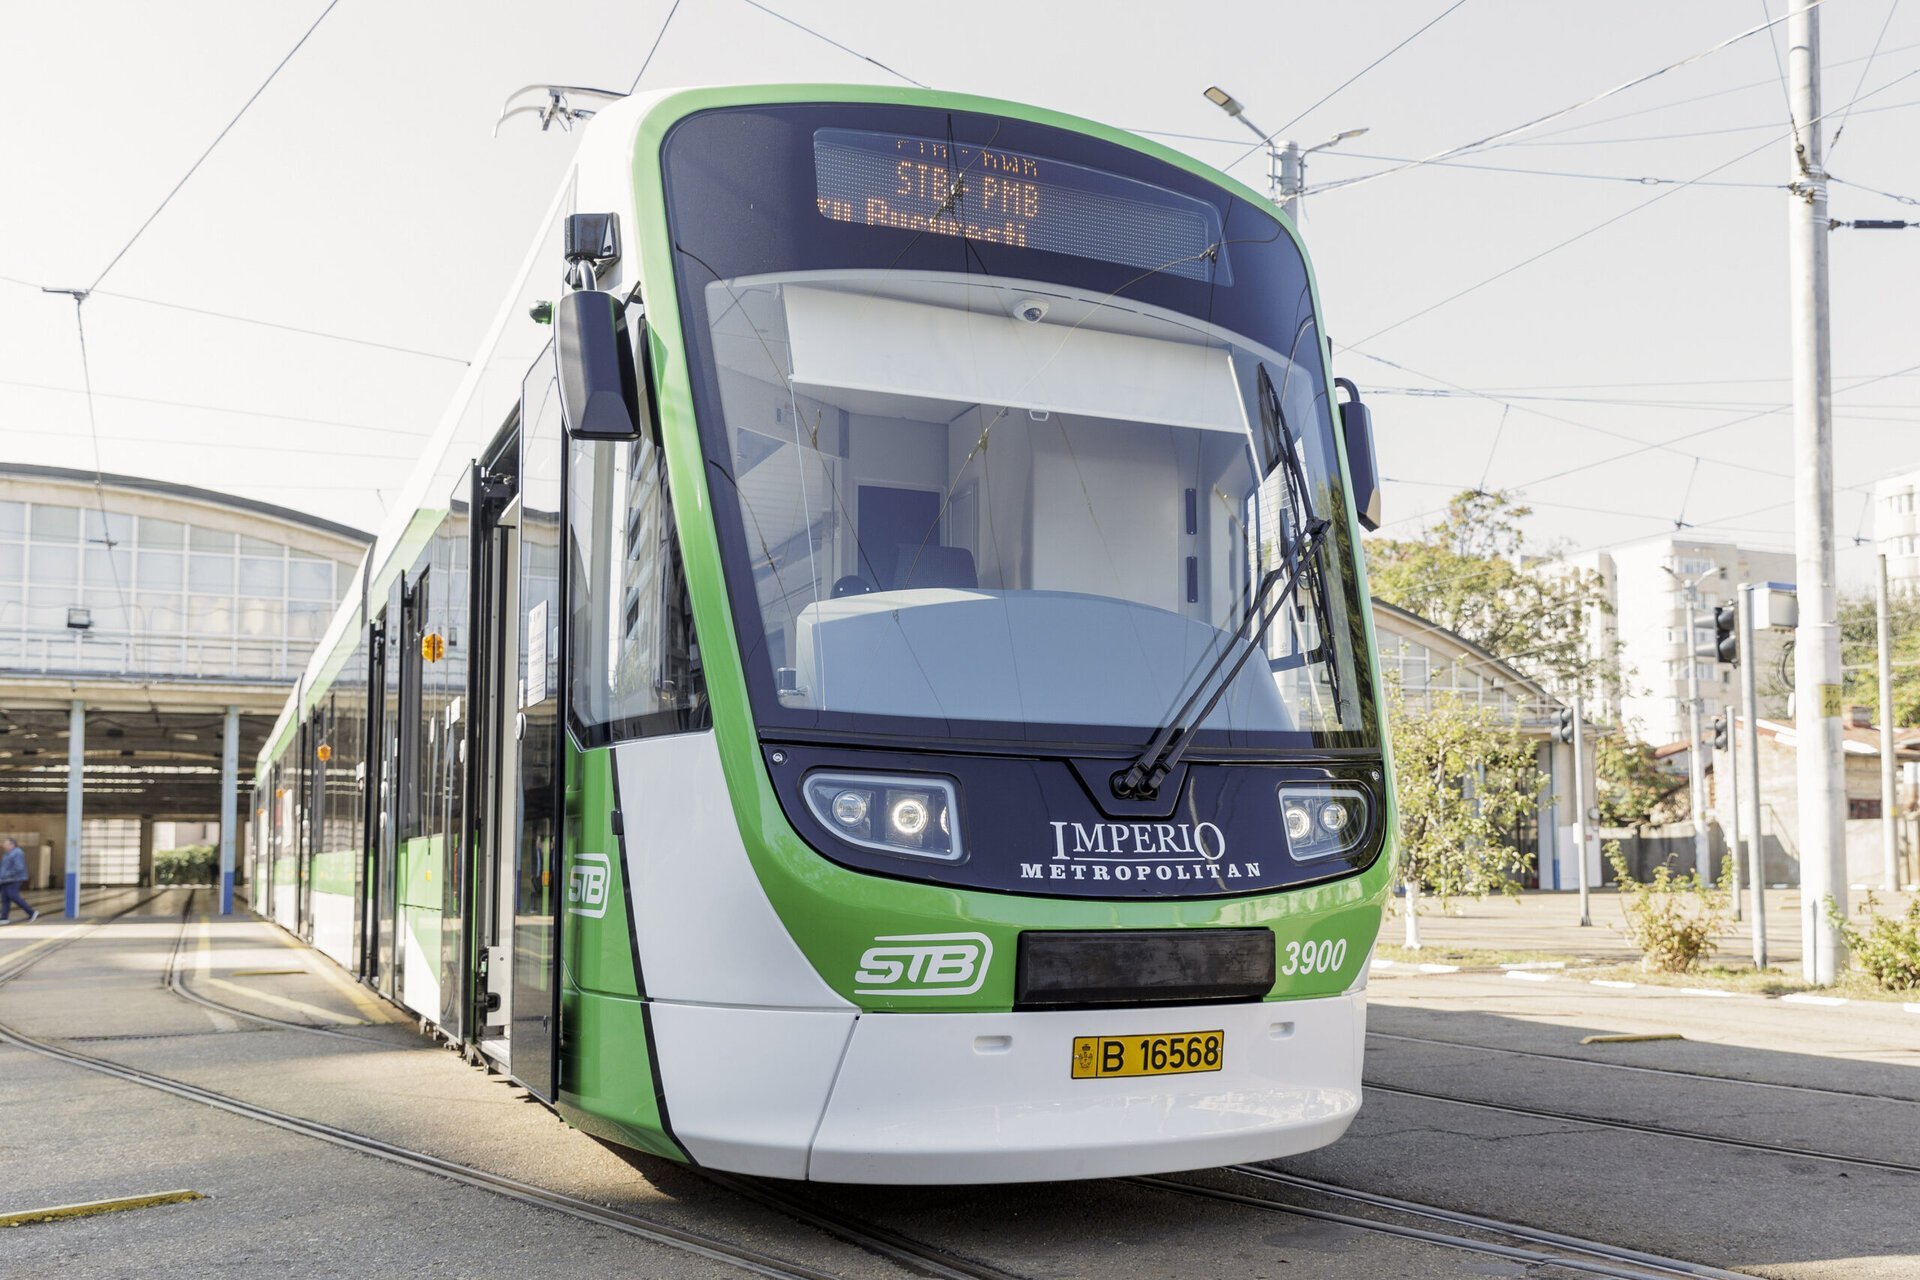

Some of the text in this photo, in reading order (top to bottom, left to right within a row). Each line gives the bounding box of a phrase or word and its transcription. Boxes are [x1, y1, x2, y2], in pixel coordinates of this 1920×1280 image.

[898, 160, 948, 201] STB
[984, 176, 1038, 217] PMB
[1050, 821, 1226, 861] IMPERIO
[568, 865, 606, 905] STB
[1020, 862, 1261, 881] METROPOLITAN
[854, 944, 979, 984] STB
[1281, 938, 1347, 976] 3900
[1102, 1035, 1219, 1073] B 16568
